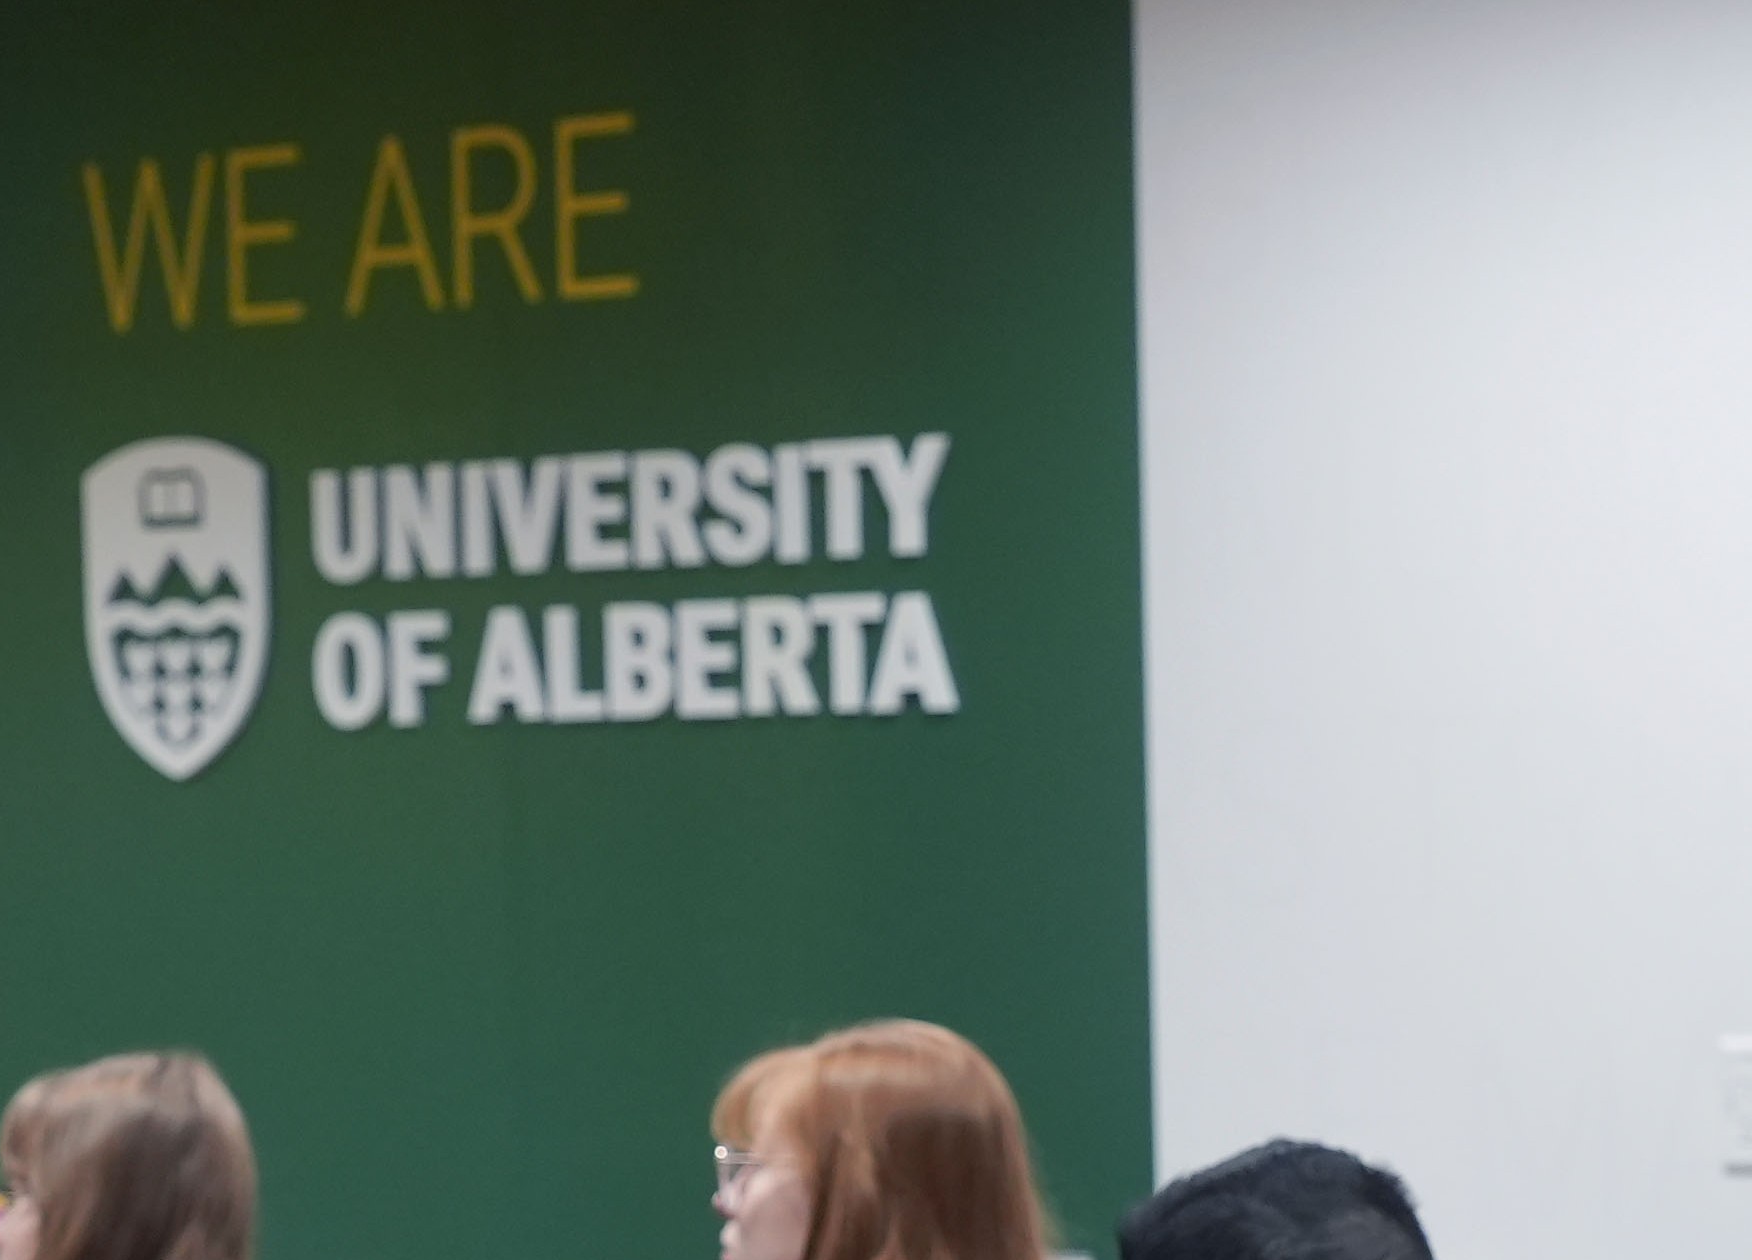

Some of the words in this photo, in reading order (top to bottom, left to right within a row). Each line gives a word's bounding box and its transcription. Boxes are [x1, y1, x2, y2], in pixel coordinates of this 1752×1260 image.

[84, 142, 305, 333] WE
[343, 111, 639, 317] ARE
[310, 433, 951, 585] UNIVERSITY
[311, 607, 452, 730] OF
[467, 592, 960, 725] ALBERTA
